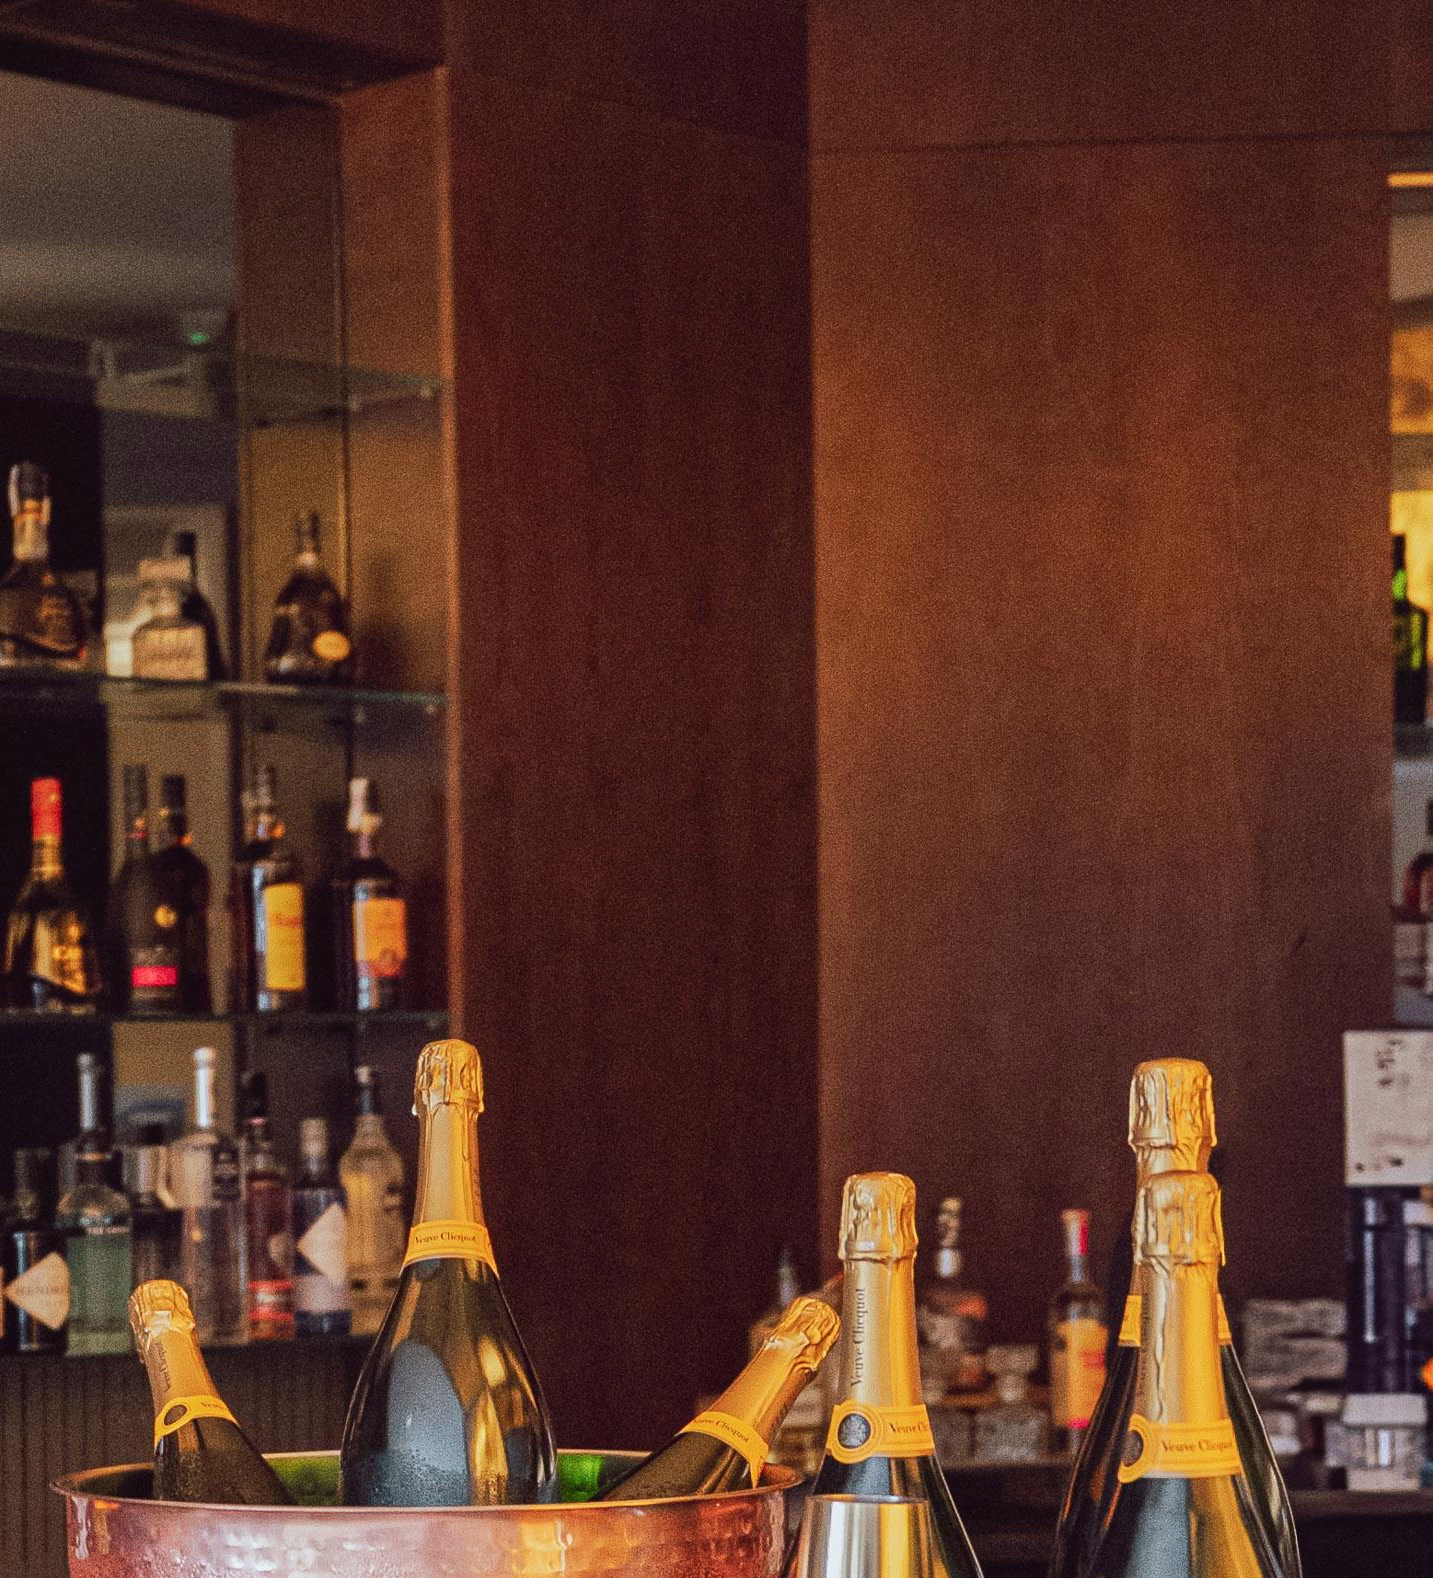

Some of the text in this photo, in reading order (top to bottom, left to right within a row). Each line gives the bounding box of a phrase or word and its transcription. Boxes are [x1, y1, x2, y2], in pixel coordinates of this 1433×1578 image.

[440, 1231, 477, 1243] Clicquot
[851, 1288, 868, 1388] Veuve Clicquot
[889, 1422, 916, 1434] Veuve
[1161, 1440, 1195, 1452] Veuve
